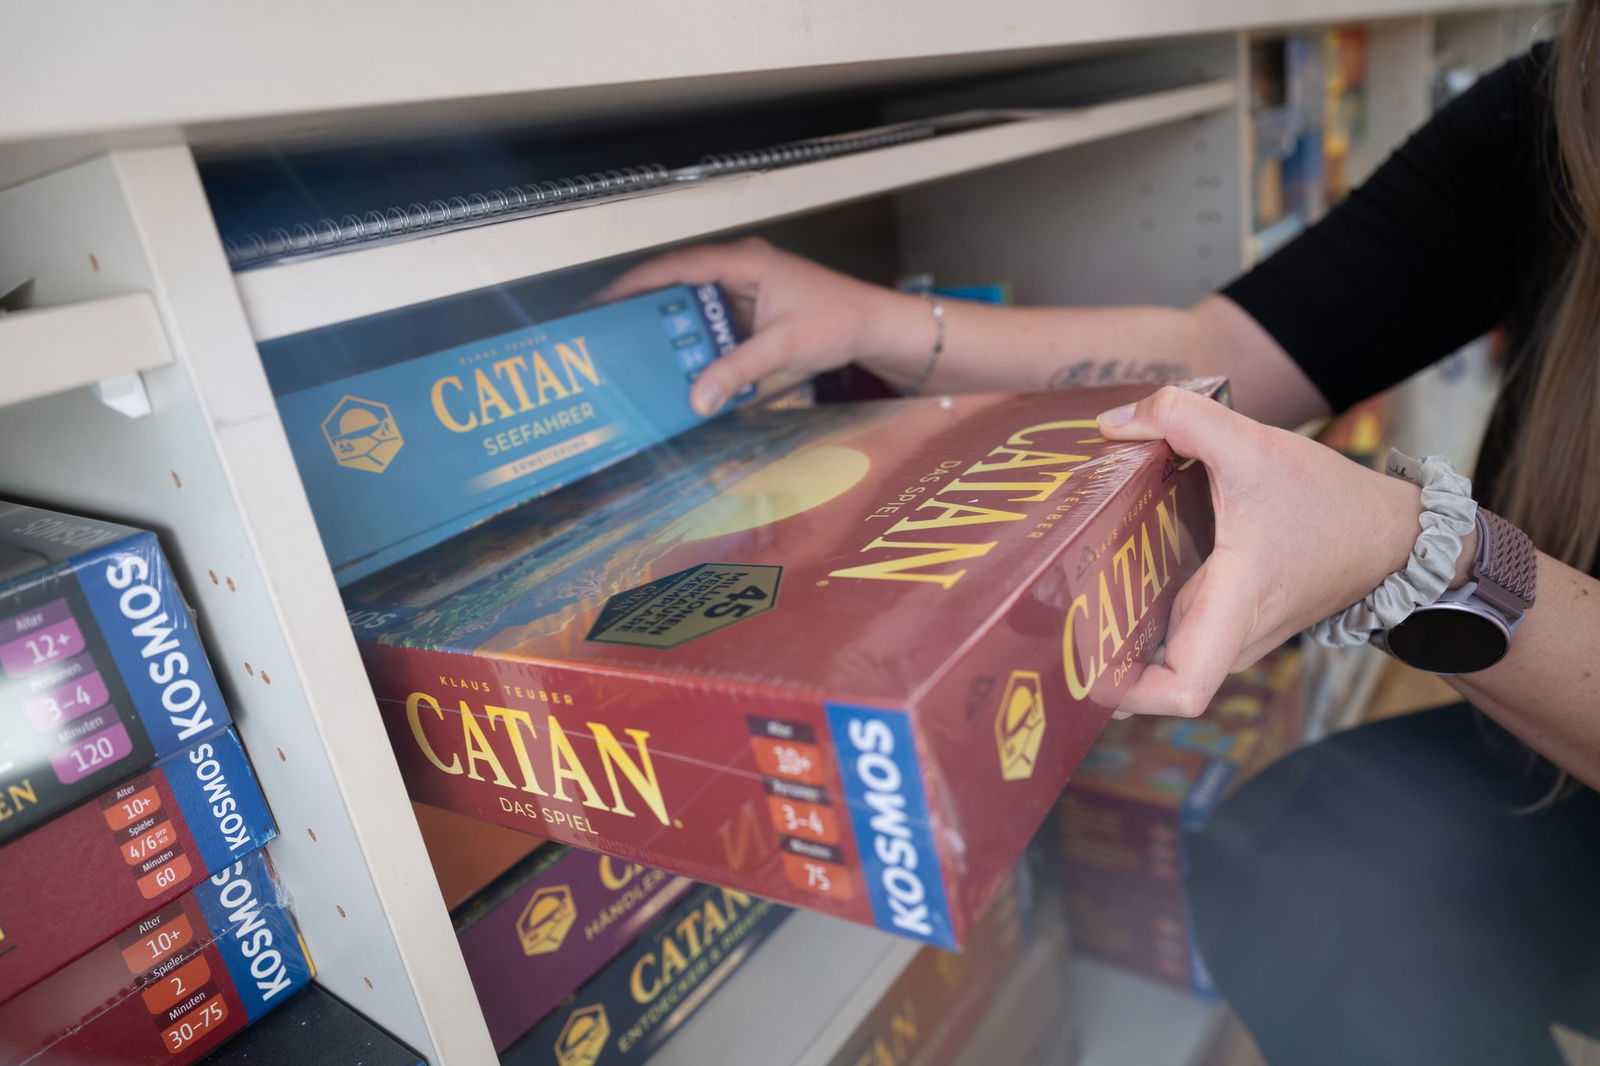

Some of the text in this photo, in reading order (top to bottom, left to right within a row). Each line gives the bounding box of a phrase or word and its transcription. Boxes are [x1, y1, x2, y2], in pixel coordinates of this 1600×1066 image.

[430, 337, 601, 434] CATAN
[482, 402, 596, 456] SEEFAHRER
[827, 419, 1108, 590] CATAN
[864, 459, 963, 523] DAS SPIEL
[1122, 488, 1154, 528] TEUBER
[616, 570, 716, 633] EXEMPLARE
[631, 571, 732, 635] VERKAUFTE
[647, 571, 750, 637] MILLIONEN
[704, 585, 769, 619] 45
[1062, 484, 1182, 701] CATAN
[15, 612, 45, 633] Alter
[25, 632, 71, 665] 12+
[106, 555, 213, 741] KOSMOS
[1113, 617, 1159, 688] DAS SPIEL
[439, 675, 574, 706] KLAUS TEUBER
[57, 714, 104, 746] Minuten
[70, 736, 114, 773] 120
[405, 691, 674, 827] CATAN
[116, 784, 136, 800] Alter
[122, 798, 151, 820] 10+
[189, 742, 251, 851] KOSMOS
[128, 817, 155, 838] Spieler
[155, 827, 168, 839] pro
[499, 796, 599, 836] DAS SPIEL
[848, 718, 933, 936] KOSMOS
[158, 835, 169, 846] Kit
[142, 850, 174, 873] Minuten
[155, 867, 176, 888] 60
[803, 862, 831, 891] 75
[138, 915, 161, 935] Alter
[211, 860, 292, 1002] KOSMOS
[146, 929, 181, 960] 10+
[153, 953, 185, 978] Spieler
[170, 977, 186, 996] 2
[168, 991, 206, 1021] Minuten
